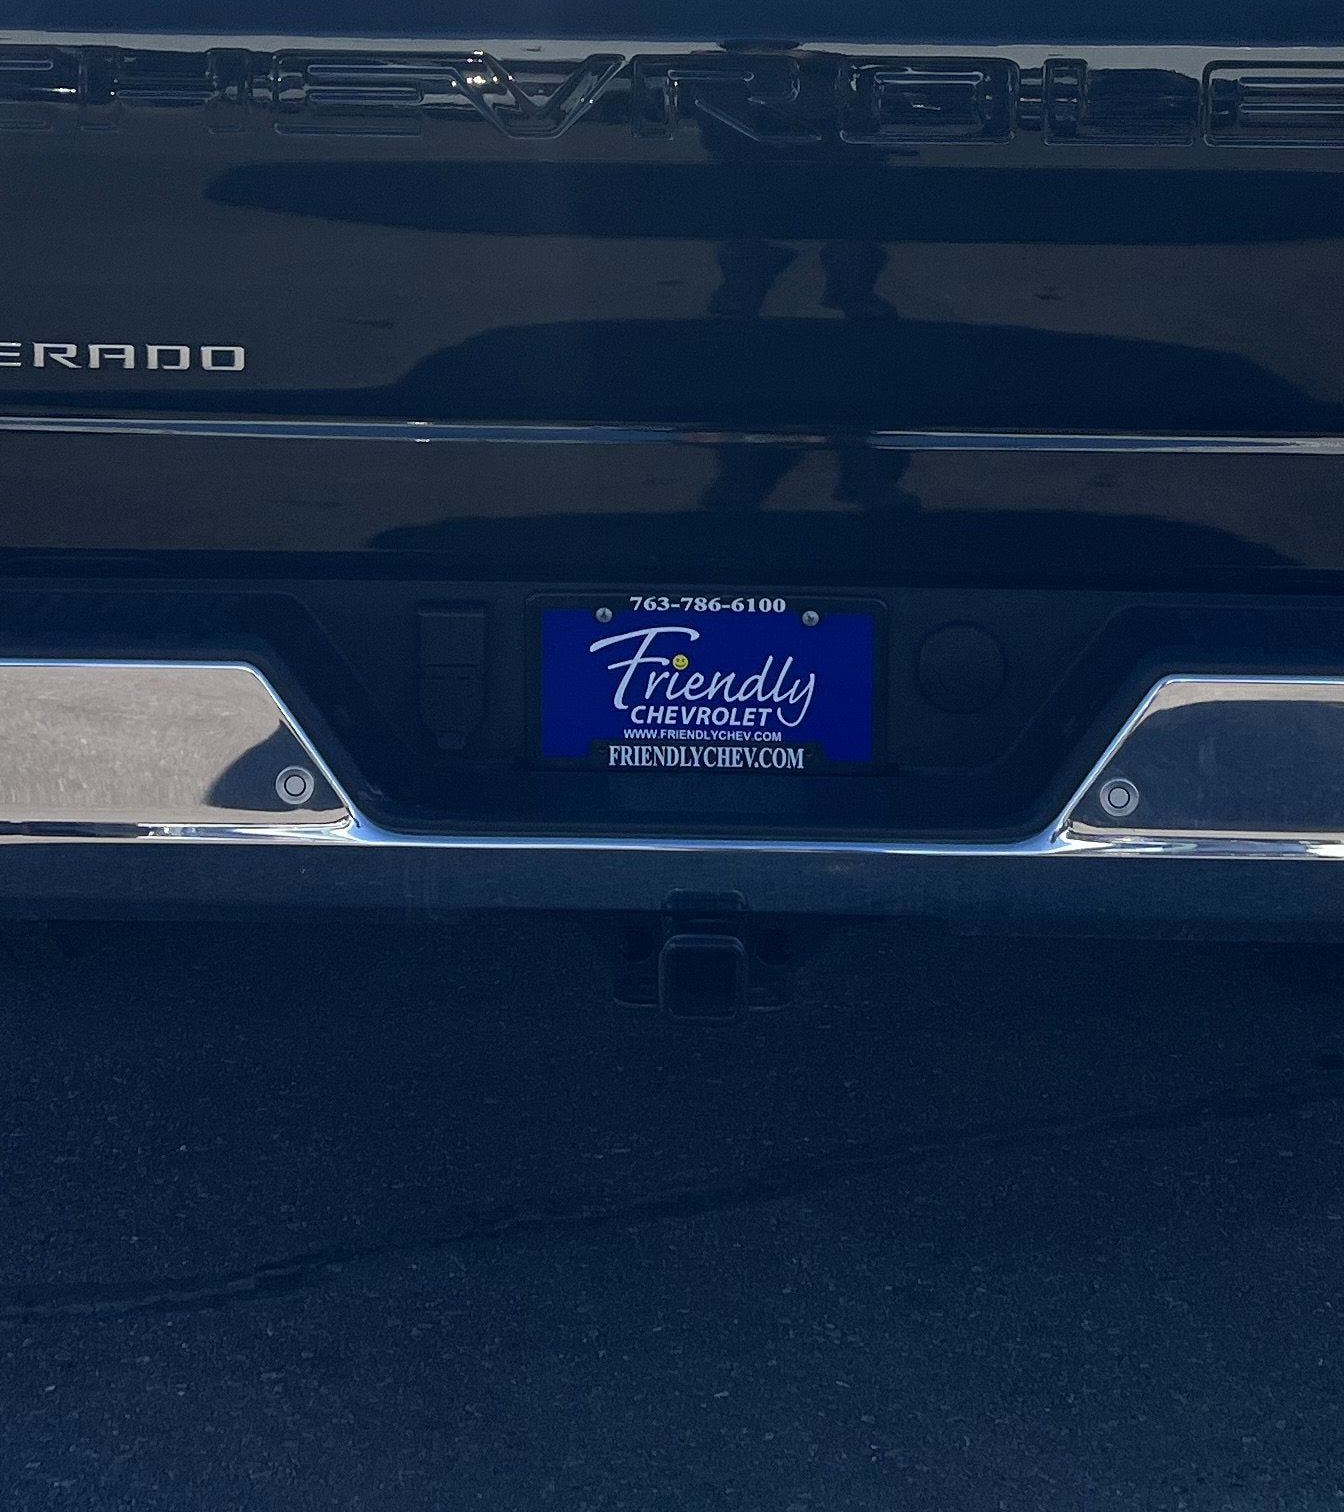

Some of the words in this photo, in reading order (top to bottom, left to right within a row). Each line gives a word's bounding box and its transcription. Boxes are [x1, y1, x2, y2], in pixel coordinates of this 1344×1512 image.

[629, 596, 787, 613] 763-786-6100
[589, 626, 816, 727] Friendly
[630, 705, 772, 727] CHEVROLET
[623, 728, 782, 742] WWW.FRIENDLYCHEV.COM
[608, 744, 805, 769] FRIENDLYCHEV.COM
